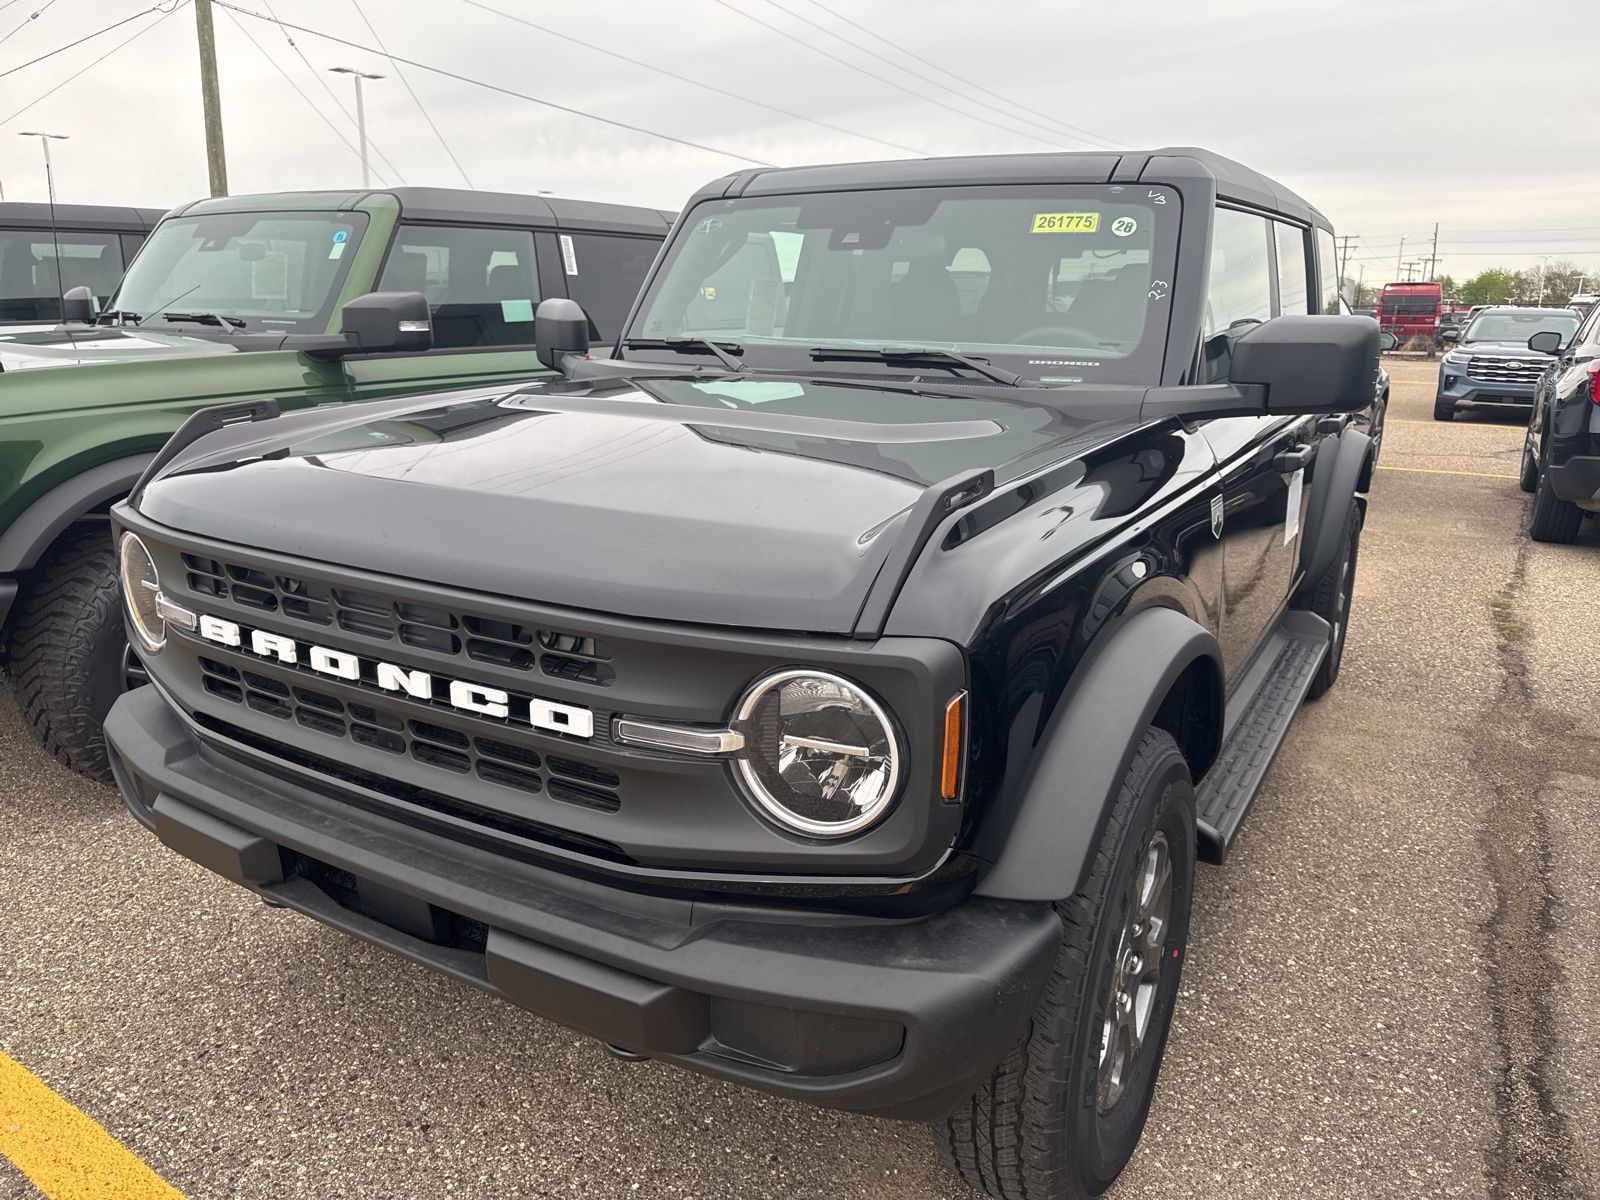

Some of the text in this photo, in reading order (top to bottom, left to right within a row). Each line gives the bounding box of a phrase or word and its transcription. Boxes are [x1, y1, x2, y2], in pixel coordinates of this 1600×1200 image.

[1038, 216, 1093, 228] 261775
[1115, 220, 1134, 233] 28
[200, 614, 594, 738] BRONCO
